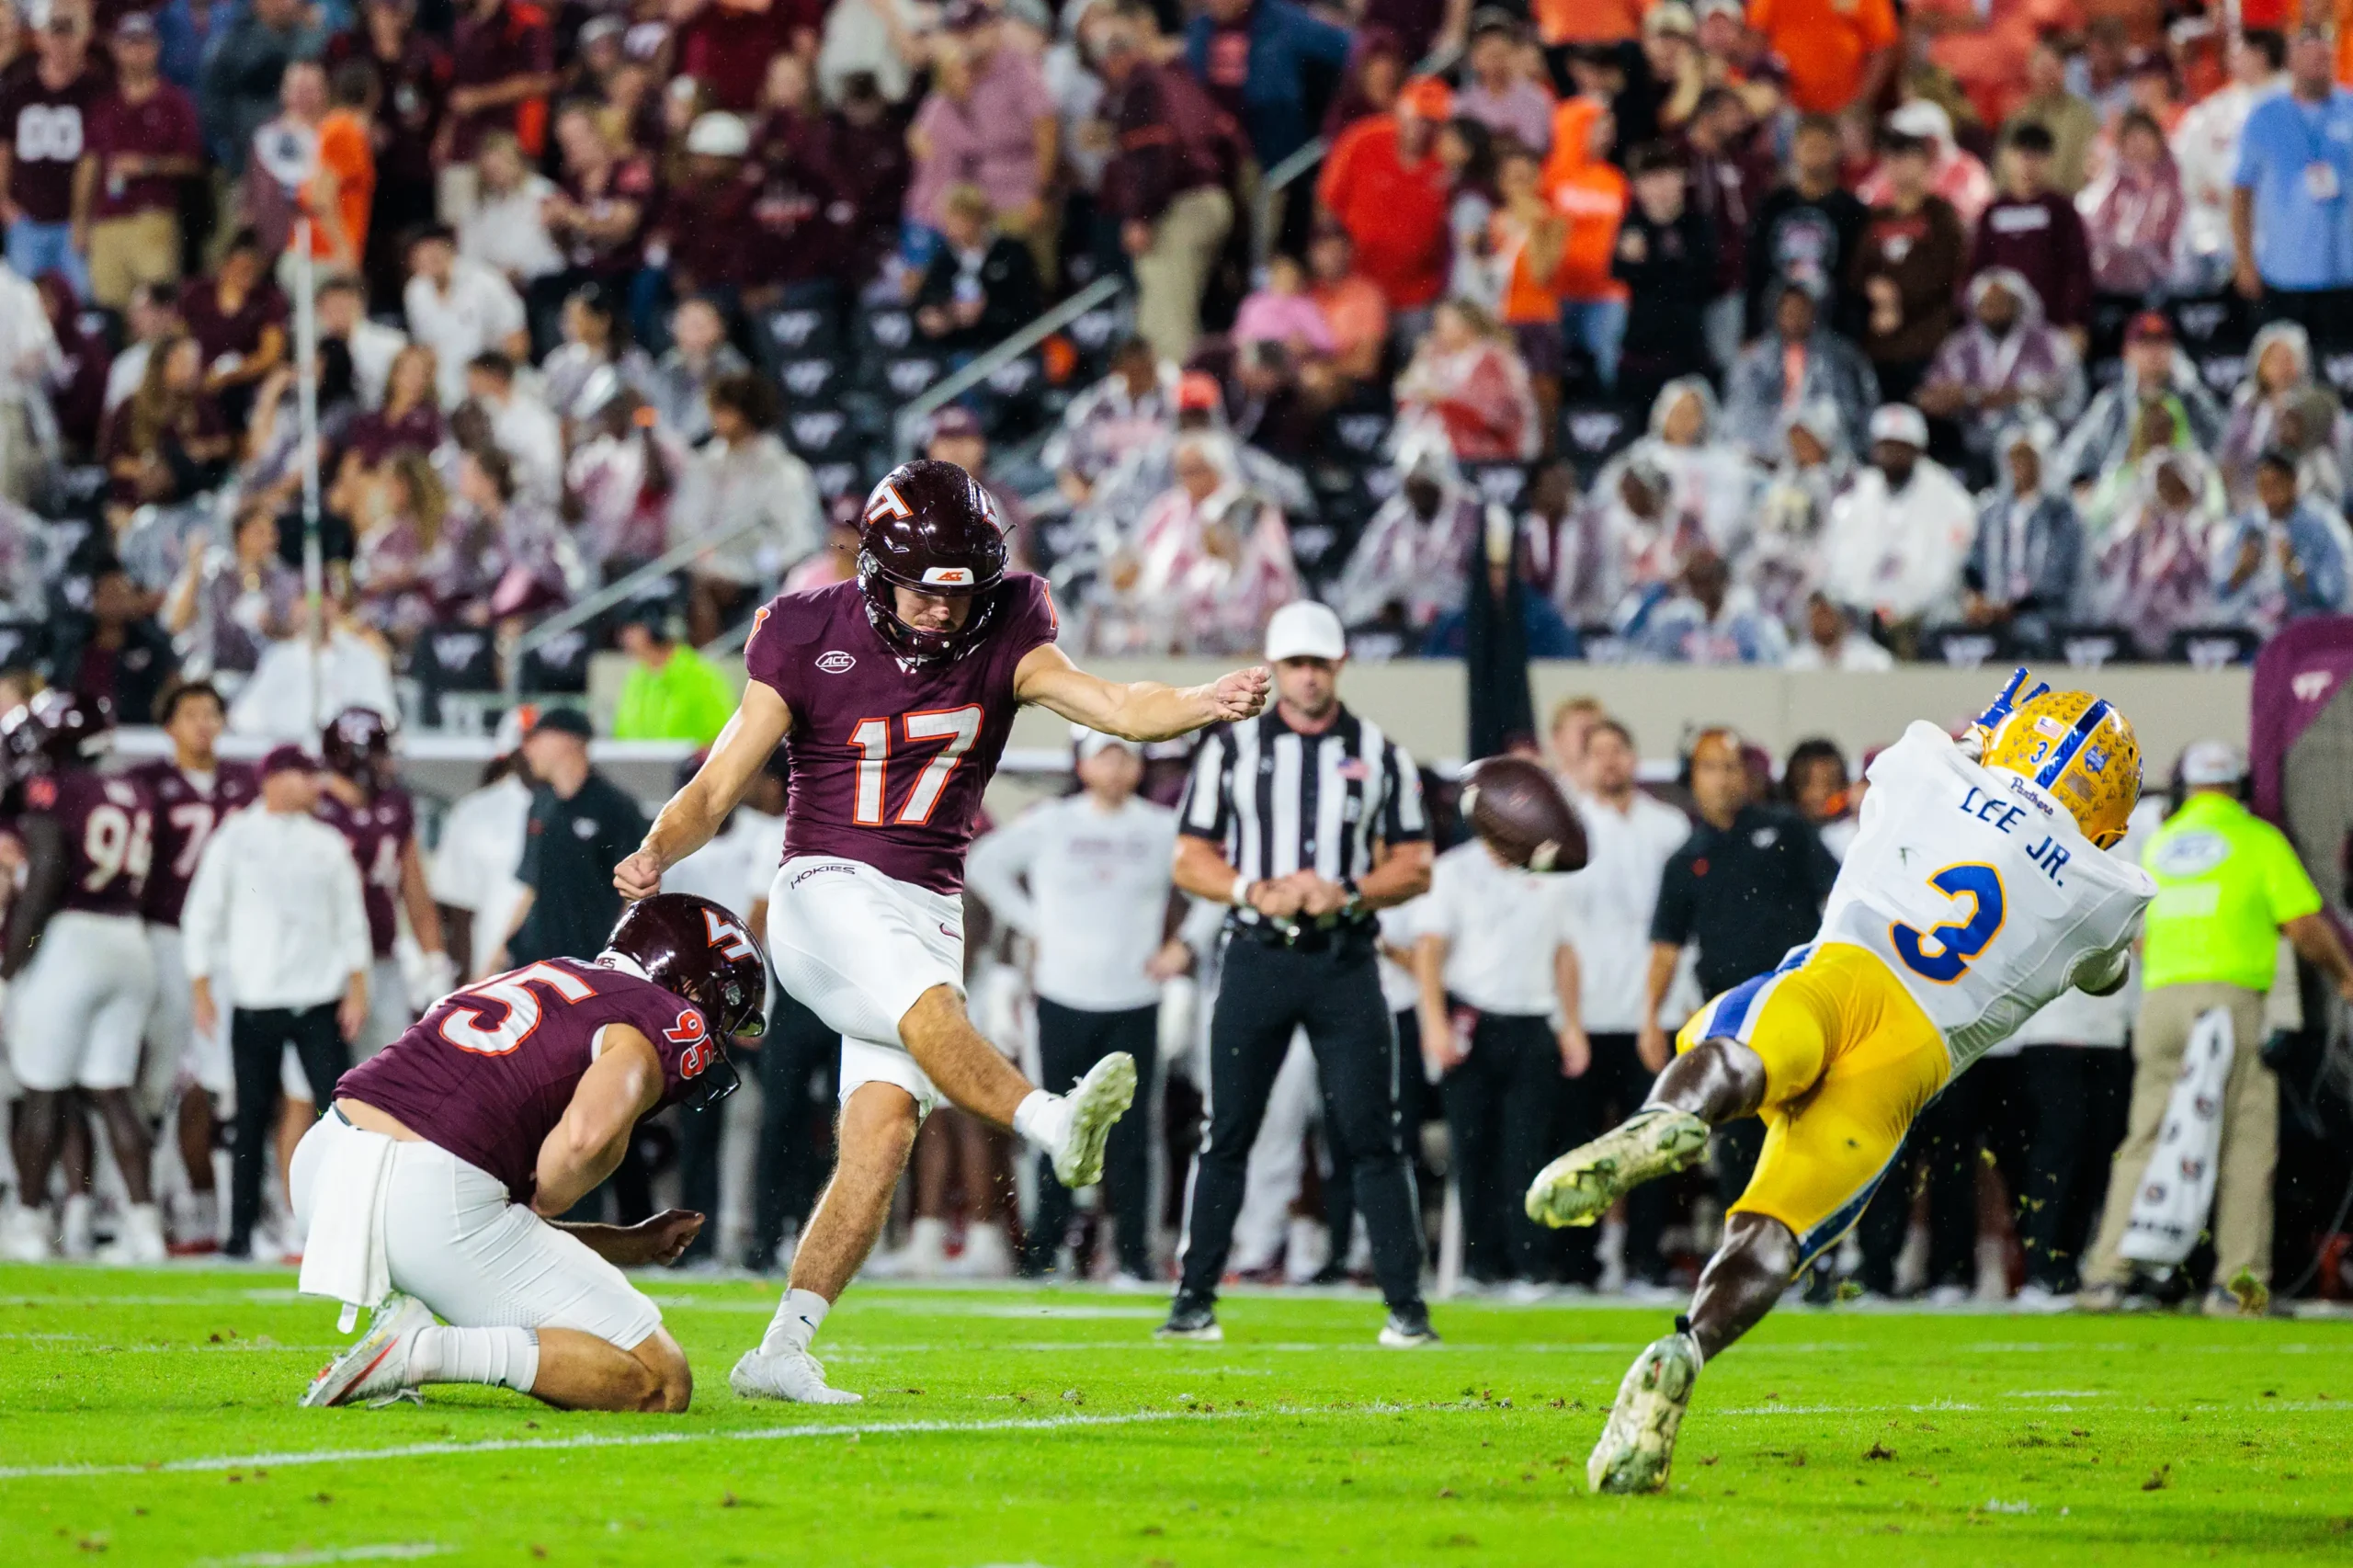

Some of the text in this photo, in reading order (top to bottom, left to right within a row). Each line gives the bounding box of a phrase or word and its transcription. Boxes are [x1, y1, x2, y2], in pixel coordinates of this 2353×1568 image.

[937, 572, 964, 581] ACC
[823, 655, 851, 666] ACC
[847, 703, 984, 826] 17
[2030, 742, 2048, 764] 3
[2010, 777, 2054, 816] Panthers
[1960, 787, 2071, 888] LEE JR.
[790, 866, 856, 891] HOKIES
[1889, 860, 2007, 986] 3
[662, 1008, 714, 1081] 95
